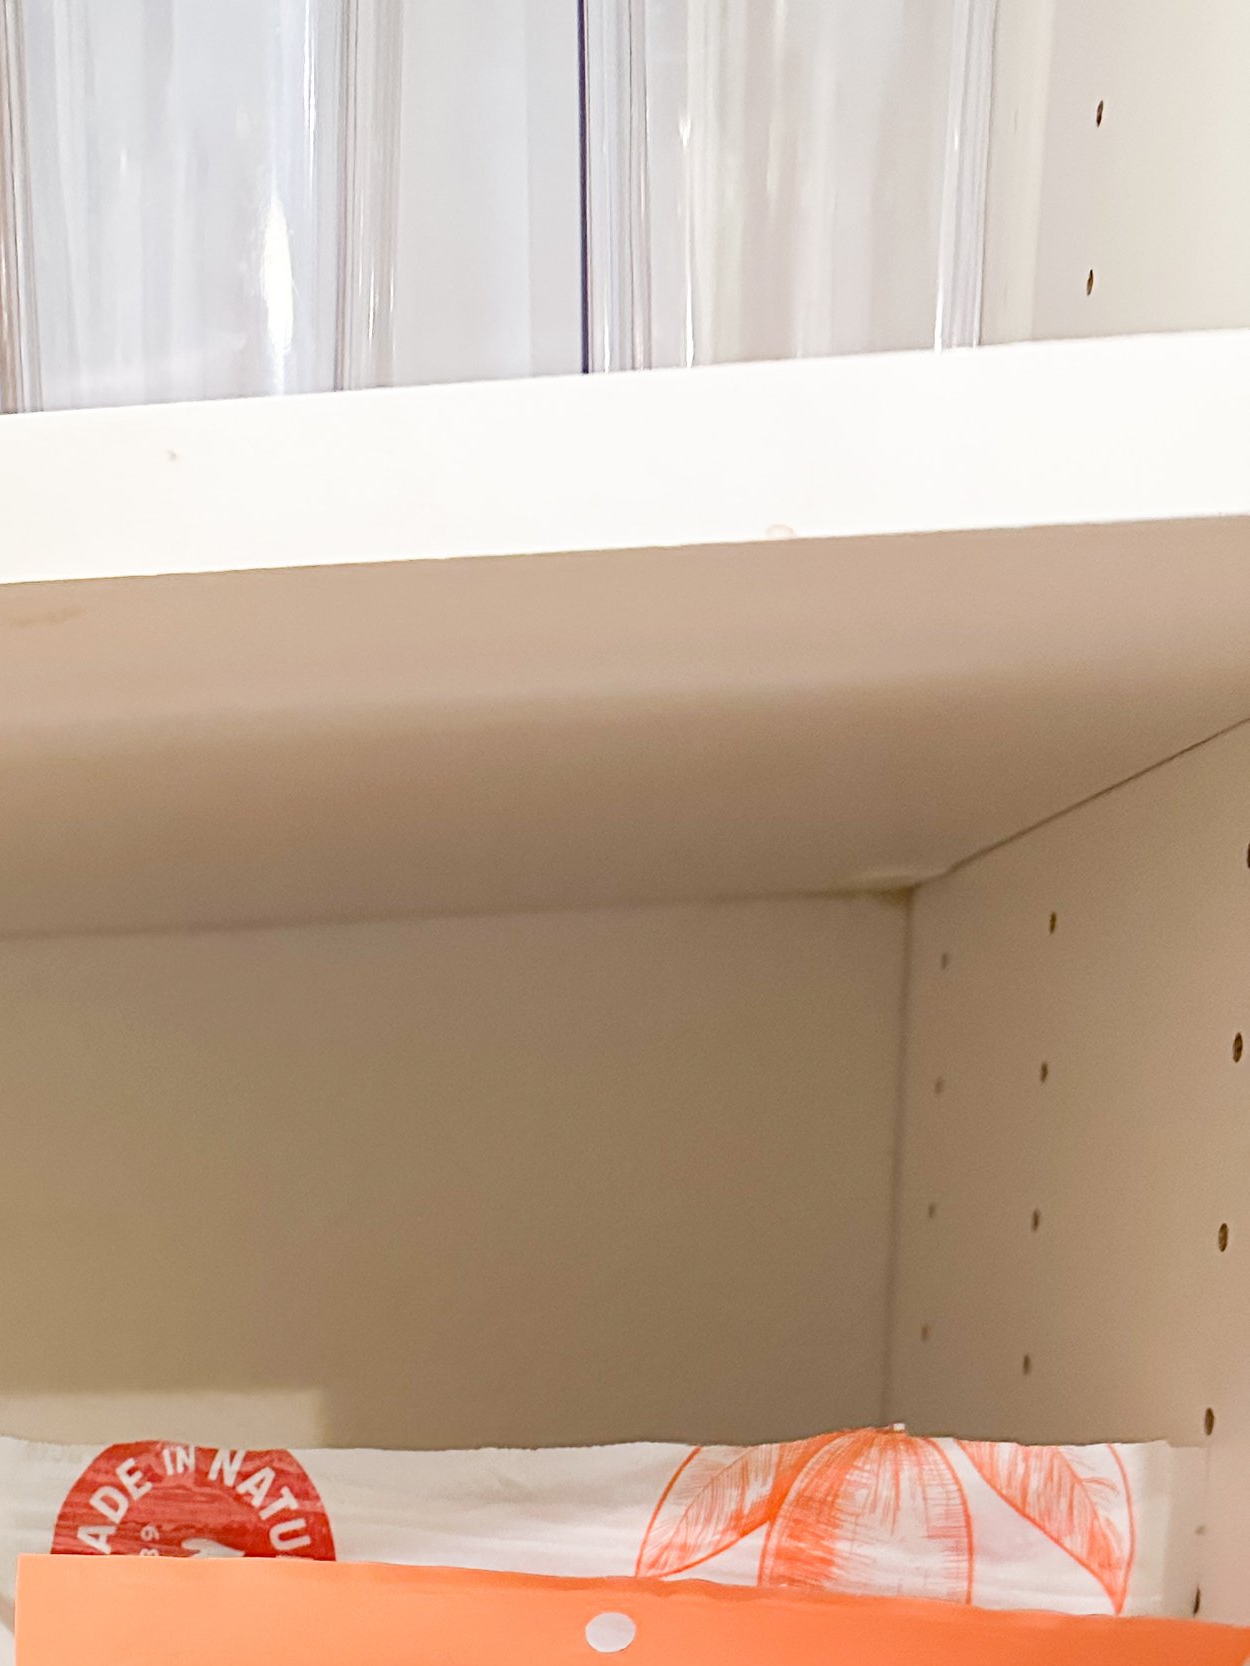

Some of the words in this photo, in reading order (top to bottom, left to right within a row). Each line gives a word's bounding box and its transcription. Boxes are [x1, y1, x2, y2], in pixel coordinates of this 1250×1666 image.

[76, 1457, 153, 1555] ADE
[161, 1446, 195, 1475] IN
[207, 1449, 312, 1552] NATU
